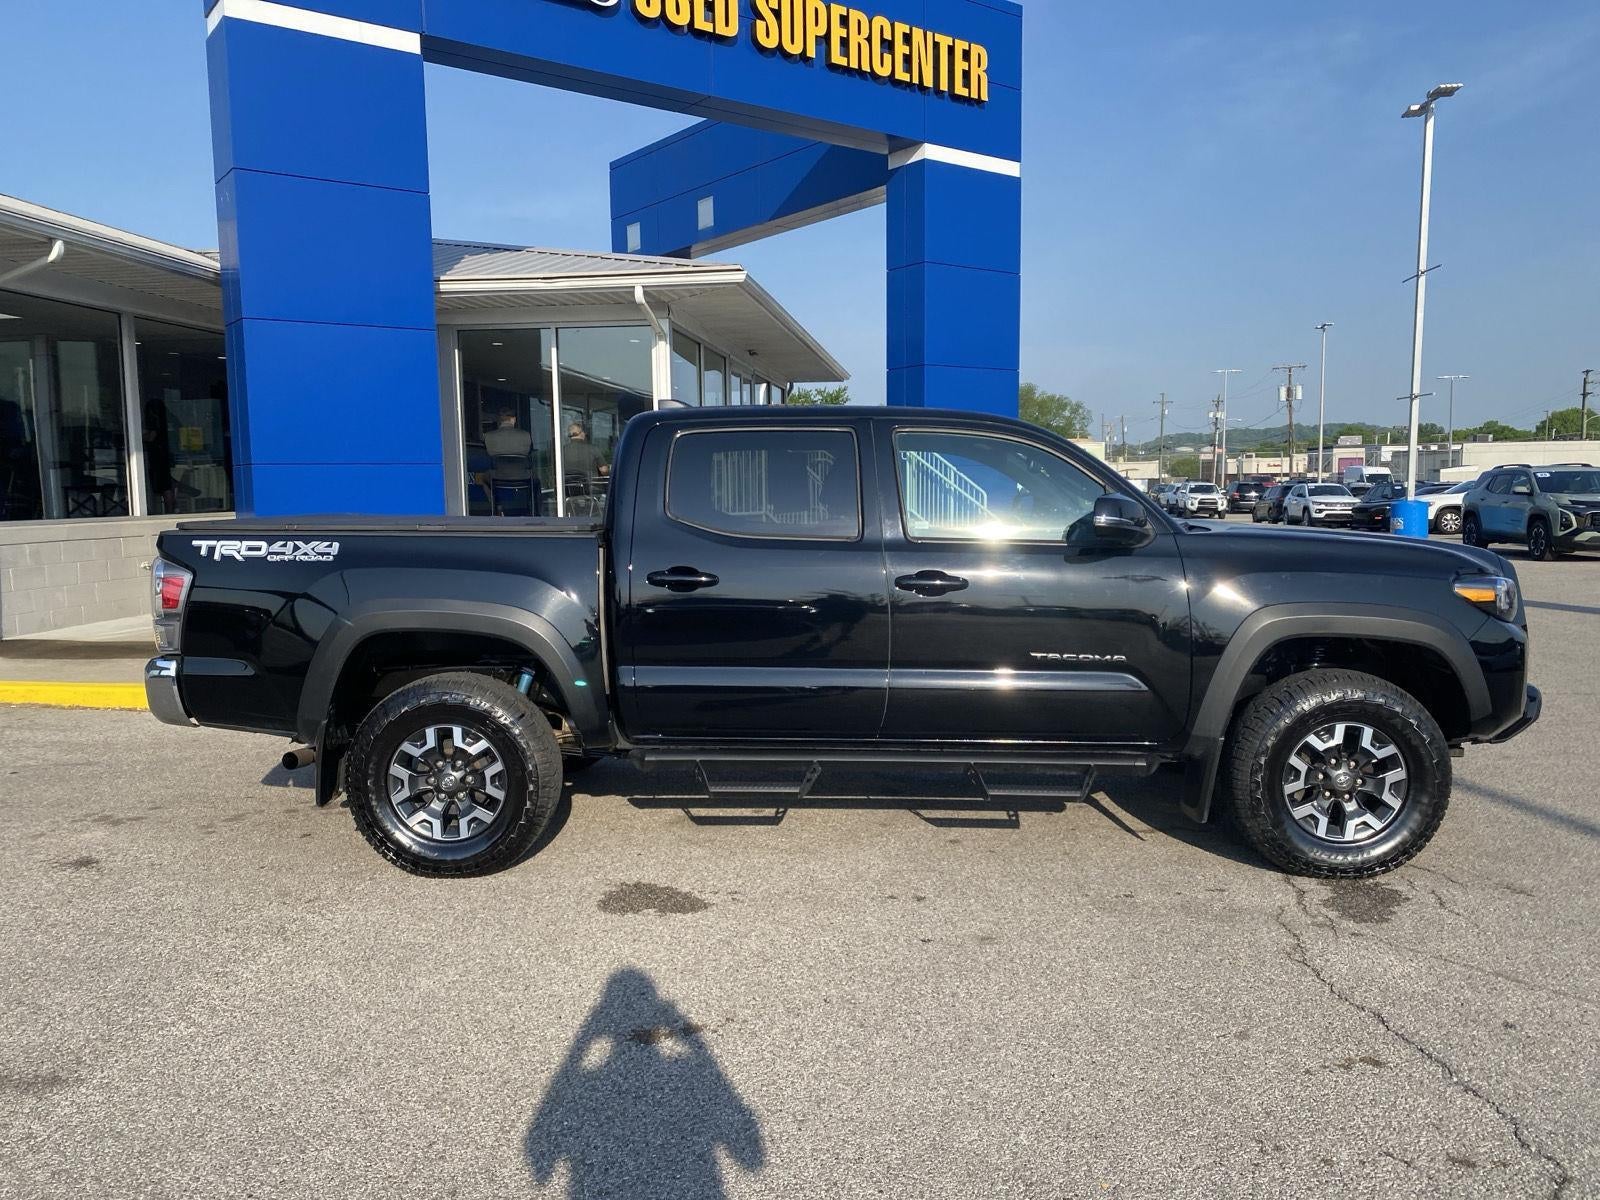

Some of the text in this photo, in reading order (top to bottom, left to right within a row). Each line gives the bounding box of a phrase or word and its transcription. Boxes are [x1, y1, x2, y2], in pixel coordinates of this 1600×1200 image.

[753, 0, 989, 102] SUPERCENTER
[267, 554, 335, 562] OFF ROAD
[1029, 651, 1127, 663] TACOMA
